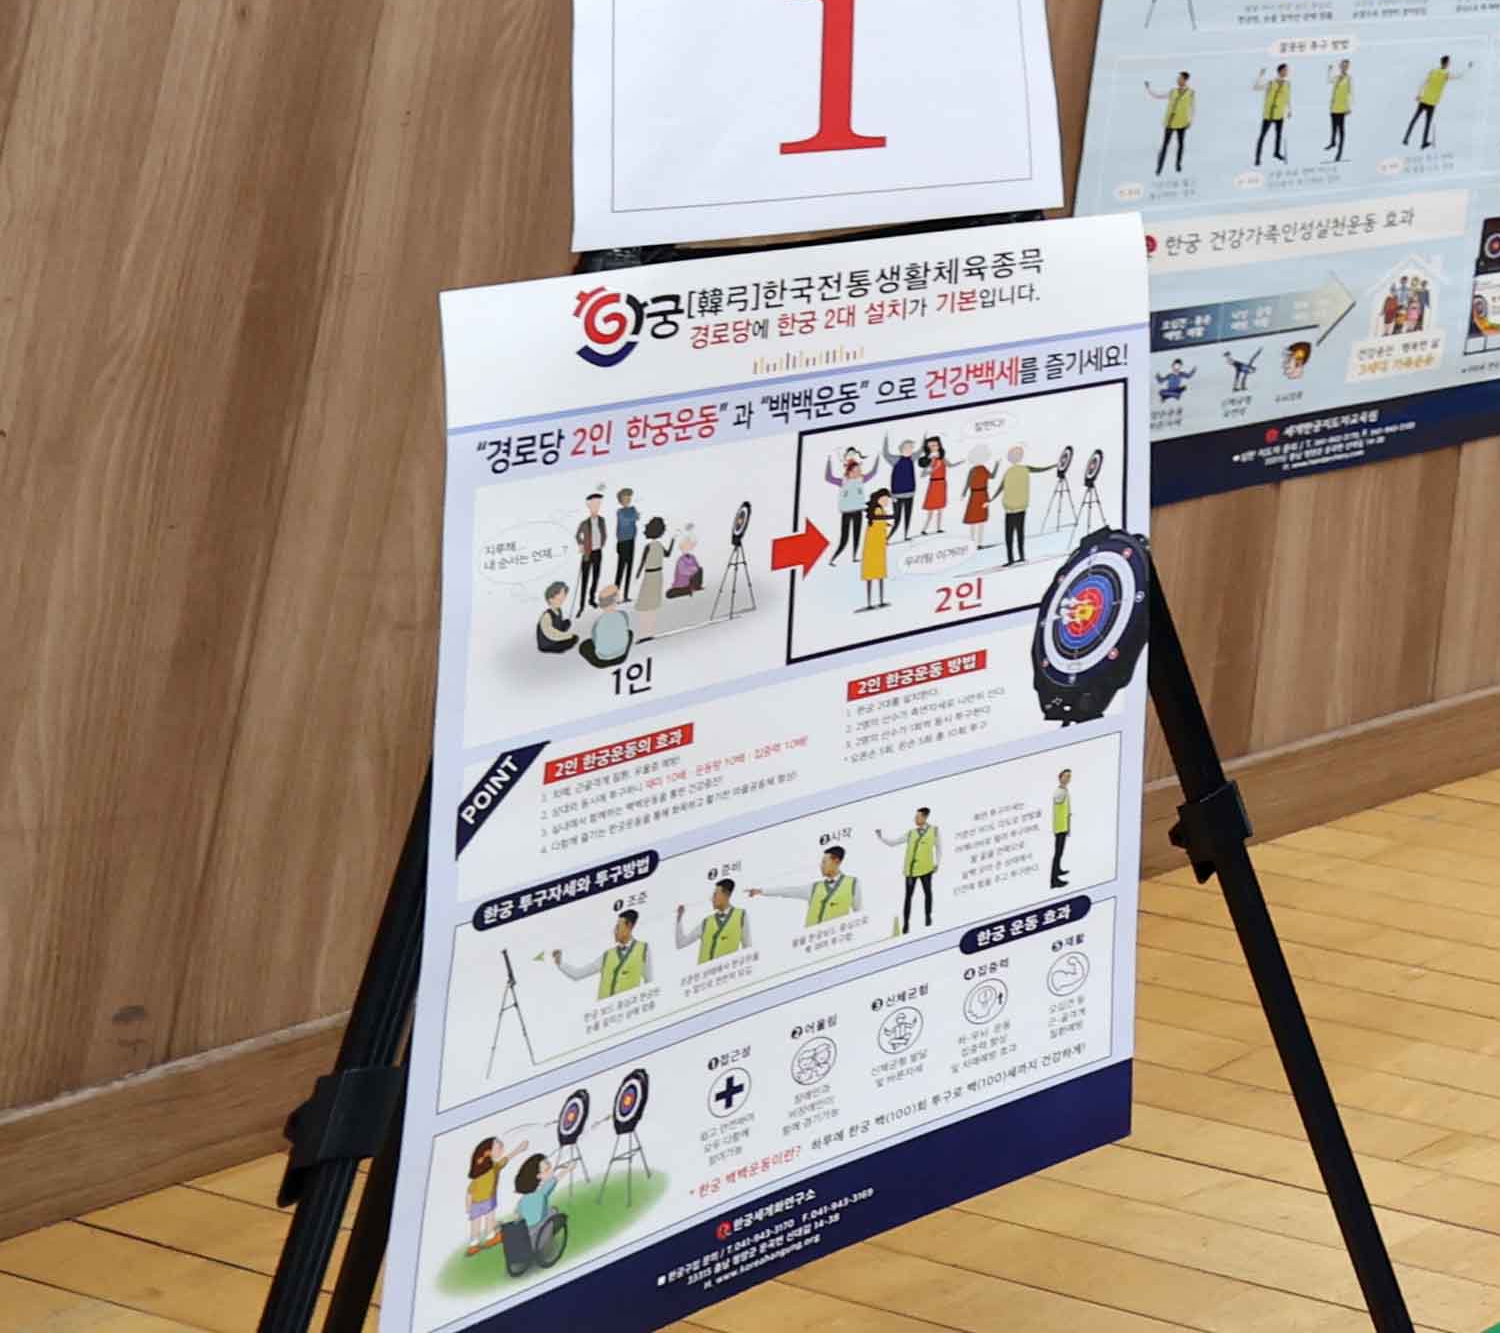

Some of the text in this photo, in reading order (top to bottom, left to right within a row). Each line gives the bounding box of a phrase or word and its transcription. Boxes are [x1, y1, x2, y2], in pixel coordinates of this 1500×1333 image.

[1165, 232, 1202, 257] 한궁
[1383, 208, 1415, 229] 효과
[689, 282, 1041, 350] 경로당에 한궁 2대 설치가 기본입니다.
[570, 419, 613, 457] 2인
[732, 400, 754, 430] 과
[875, 376, 918, 406] 으로
[925, 353, 1039, 401] 건강백세를
[1044, 344, 1130, 380] 즐기세요!
[933, 577, 983, 614] 2인
[610, 656, 653, 696] 1인
[857, 680, 881, 695] 2인
[554, 760, 578, 778] 2인
[655, 729, 682, 747] 효과
[459, 753, 523, 825] POINT
[483, 856, 650, 924] 한궁 투구자세와 투구방법
[976, 904, 1071, 946] 한궁 운동 효과
